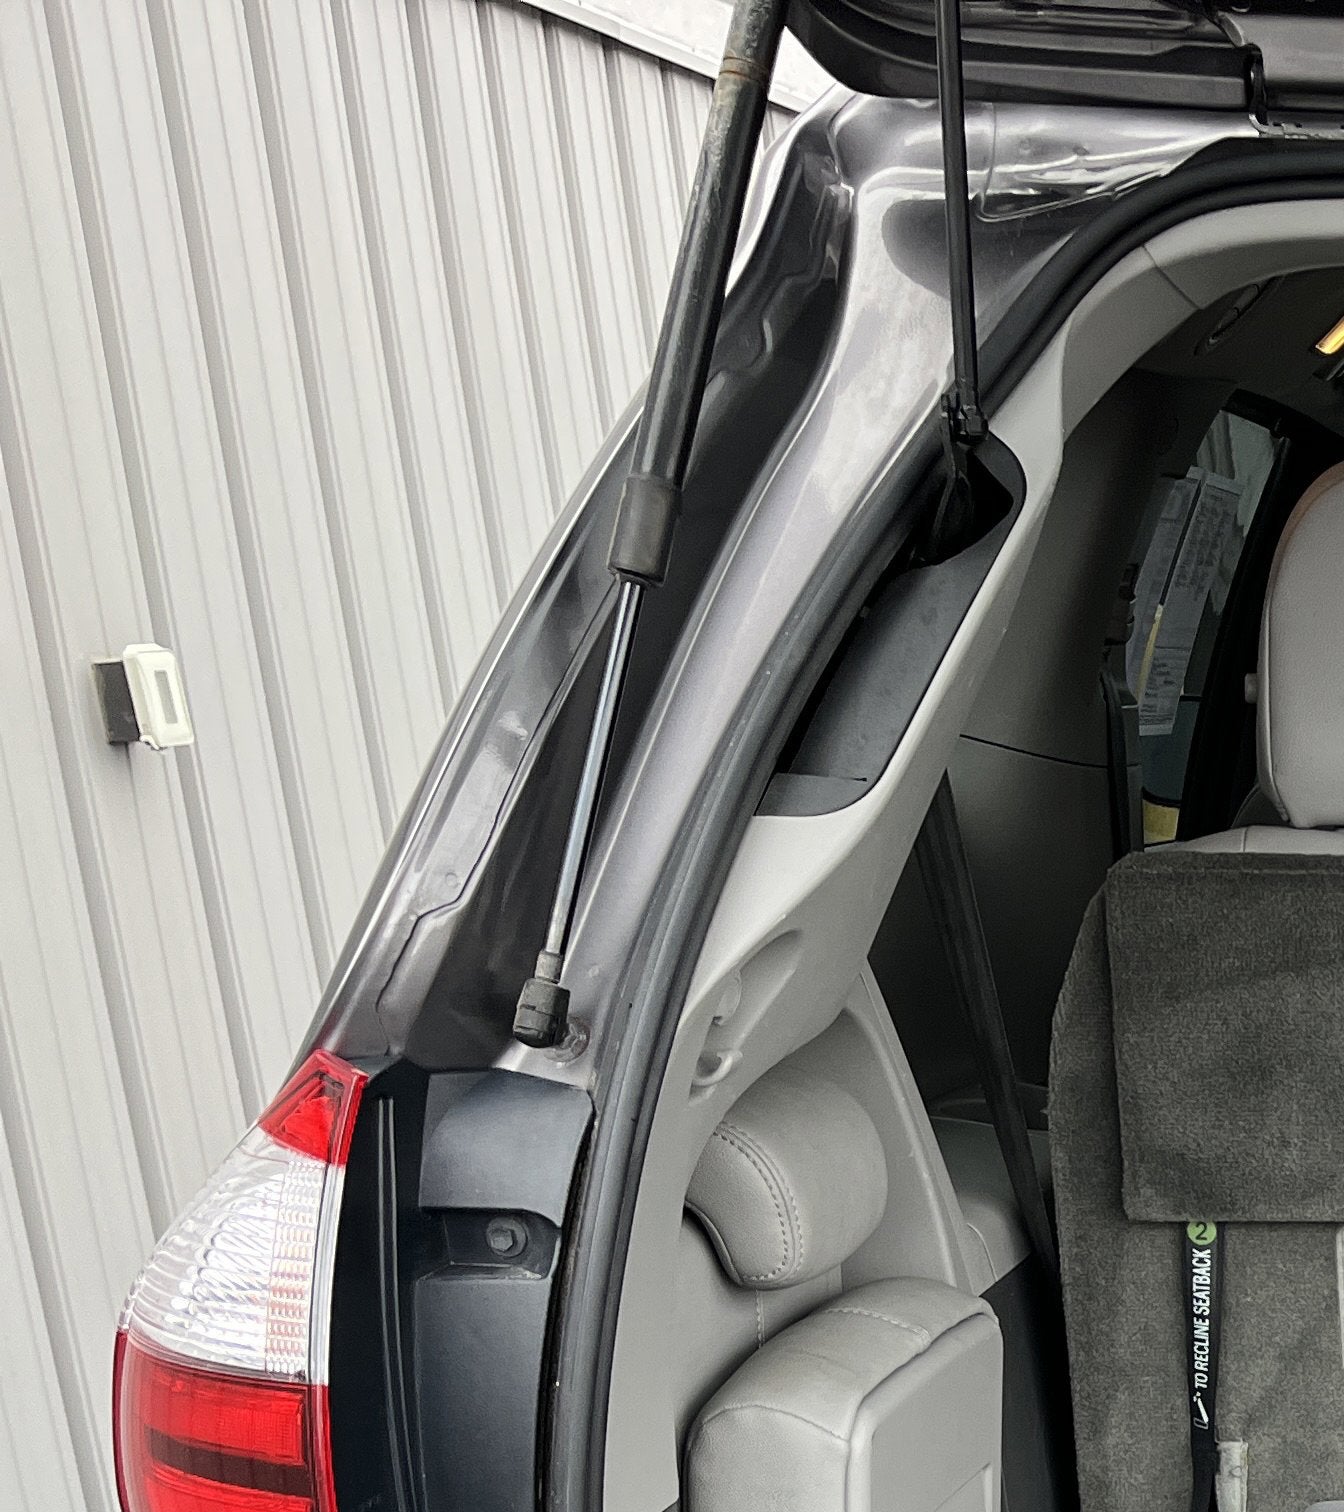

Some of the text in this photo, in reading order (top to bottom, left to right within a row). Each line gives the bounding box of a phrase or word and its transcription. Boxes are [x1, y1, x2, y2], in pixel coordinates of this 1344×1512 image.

[1195, 1221, 1208, 1240] 2
[1192, 1248, 1212, 1389] TO RECLINE SEATBACK
